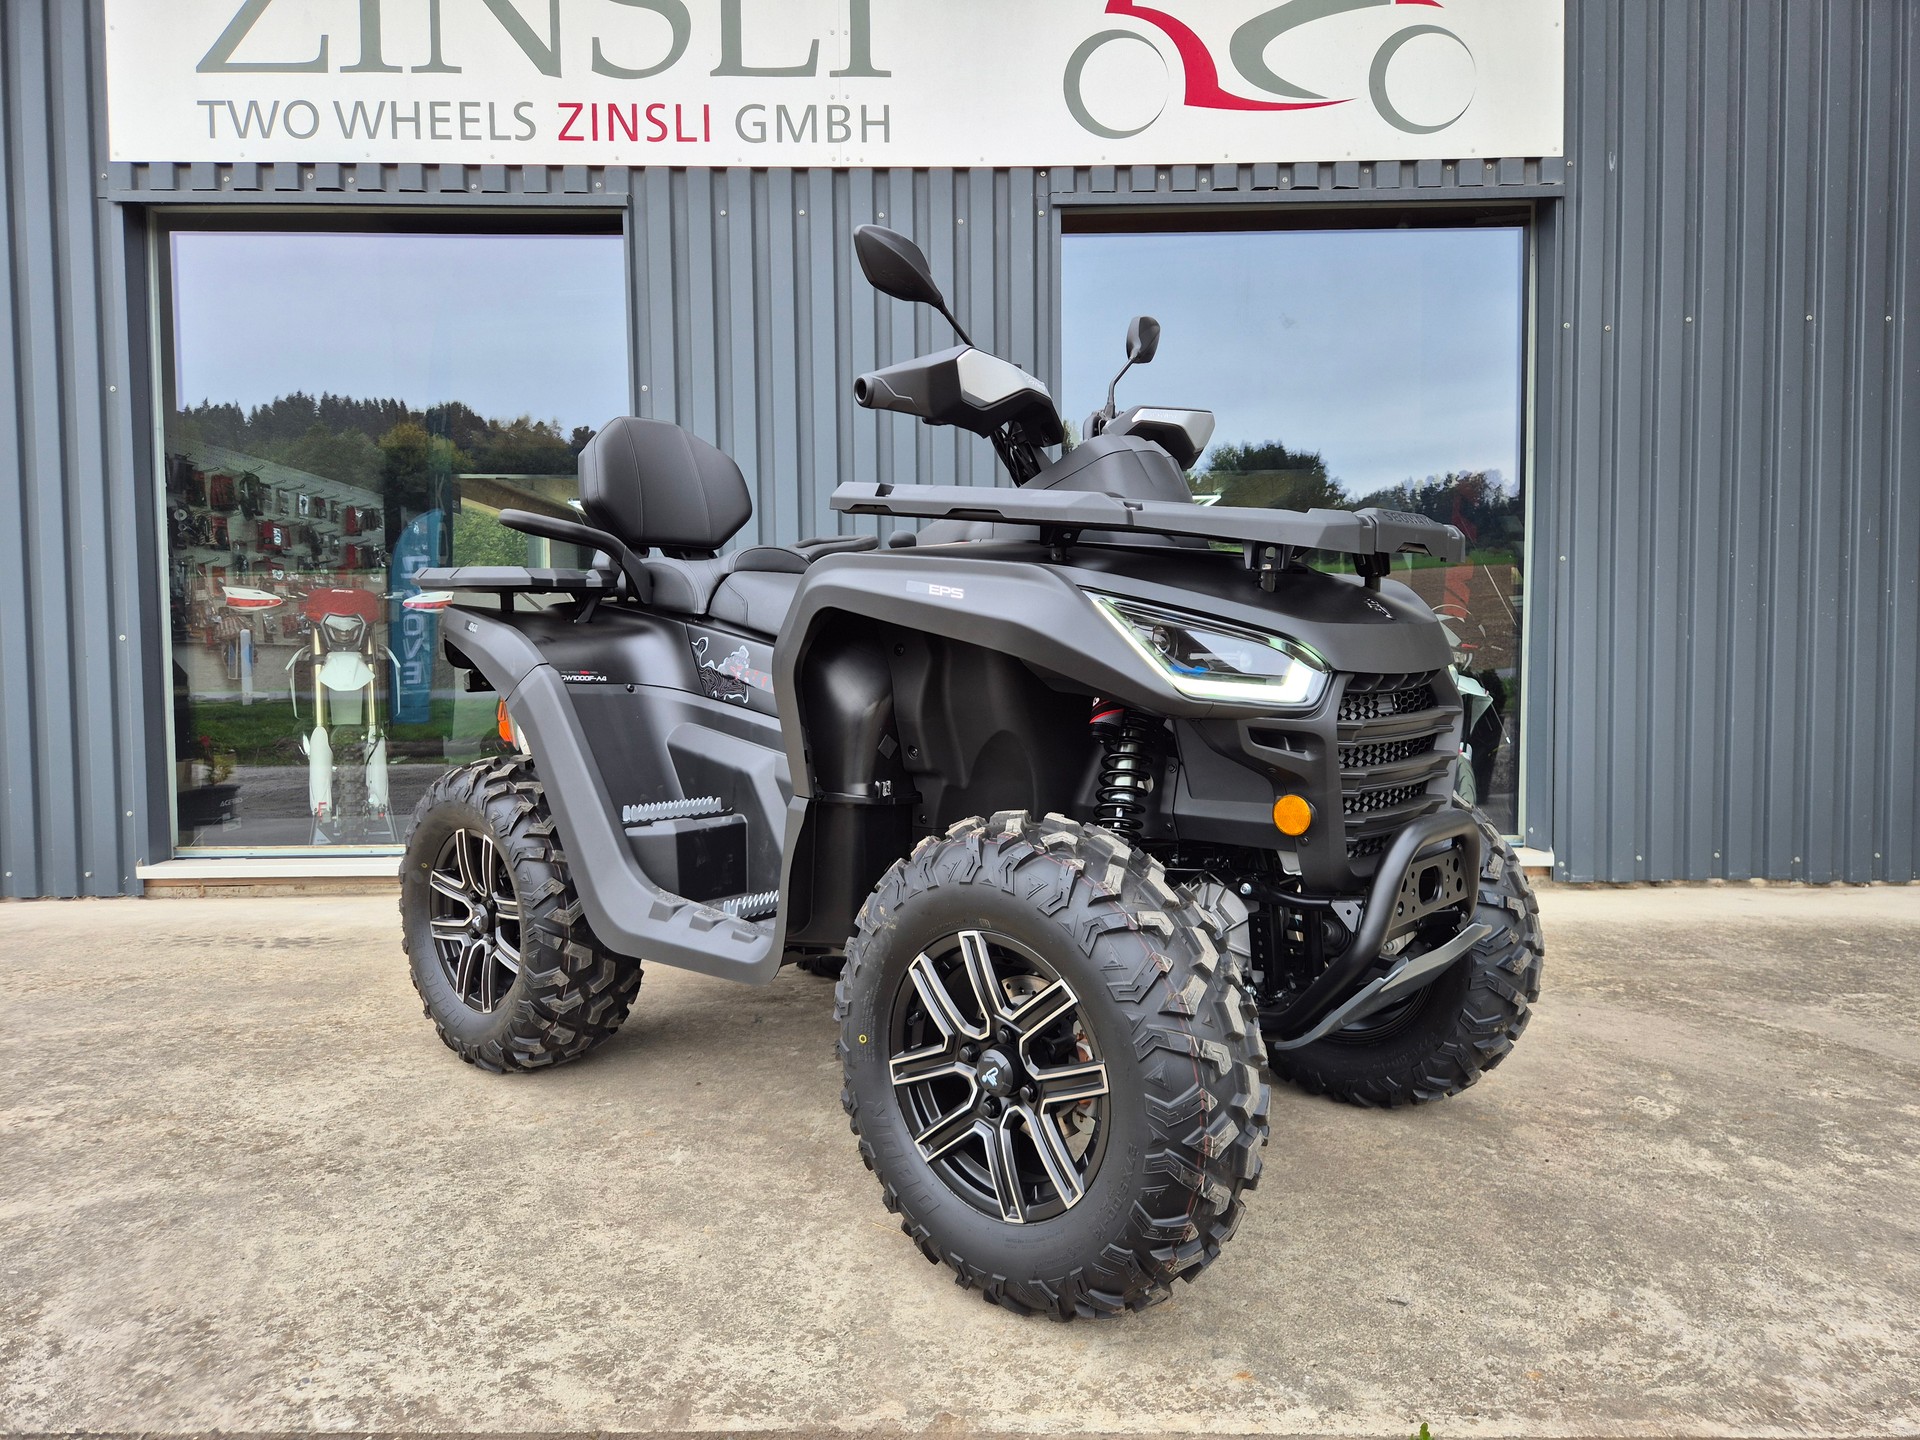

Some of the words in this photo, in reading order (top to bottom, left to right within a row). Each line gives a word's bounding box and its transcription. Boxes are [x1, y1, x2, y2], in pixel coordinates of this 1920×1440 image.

[196, 100, 320, 139] TWO
[332, 100, 537, 141] WHEELS
[557, 102, 710, 143] ZINSLI
[734, 103, 891, 143] GMBH
[928, 584, 965, 600] EPS
